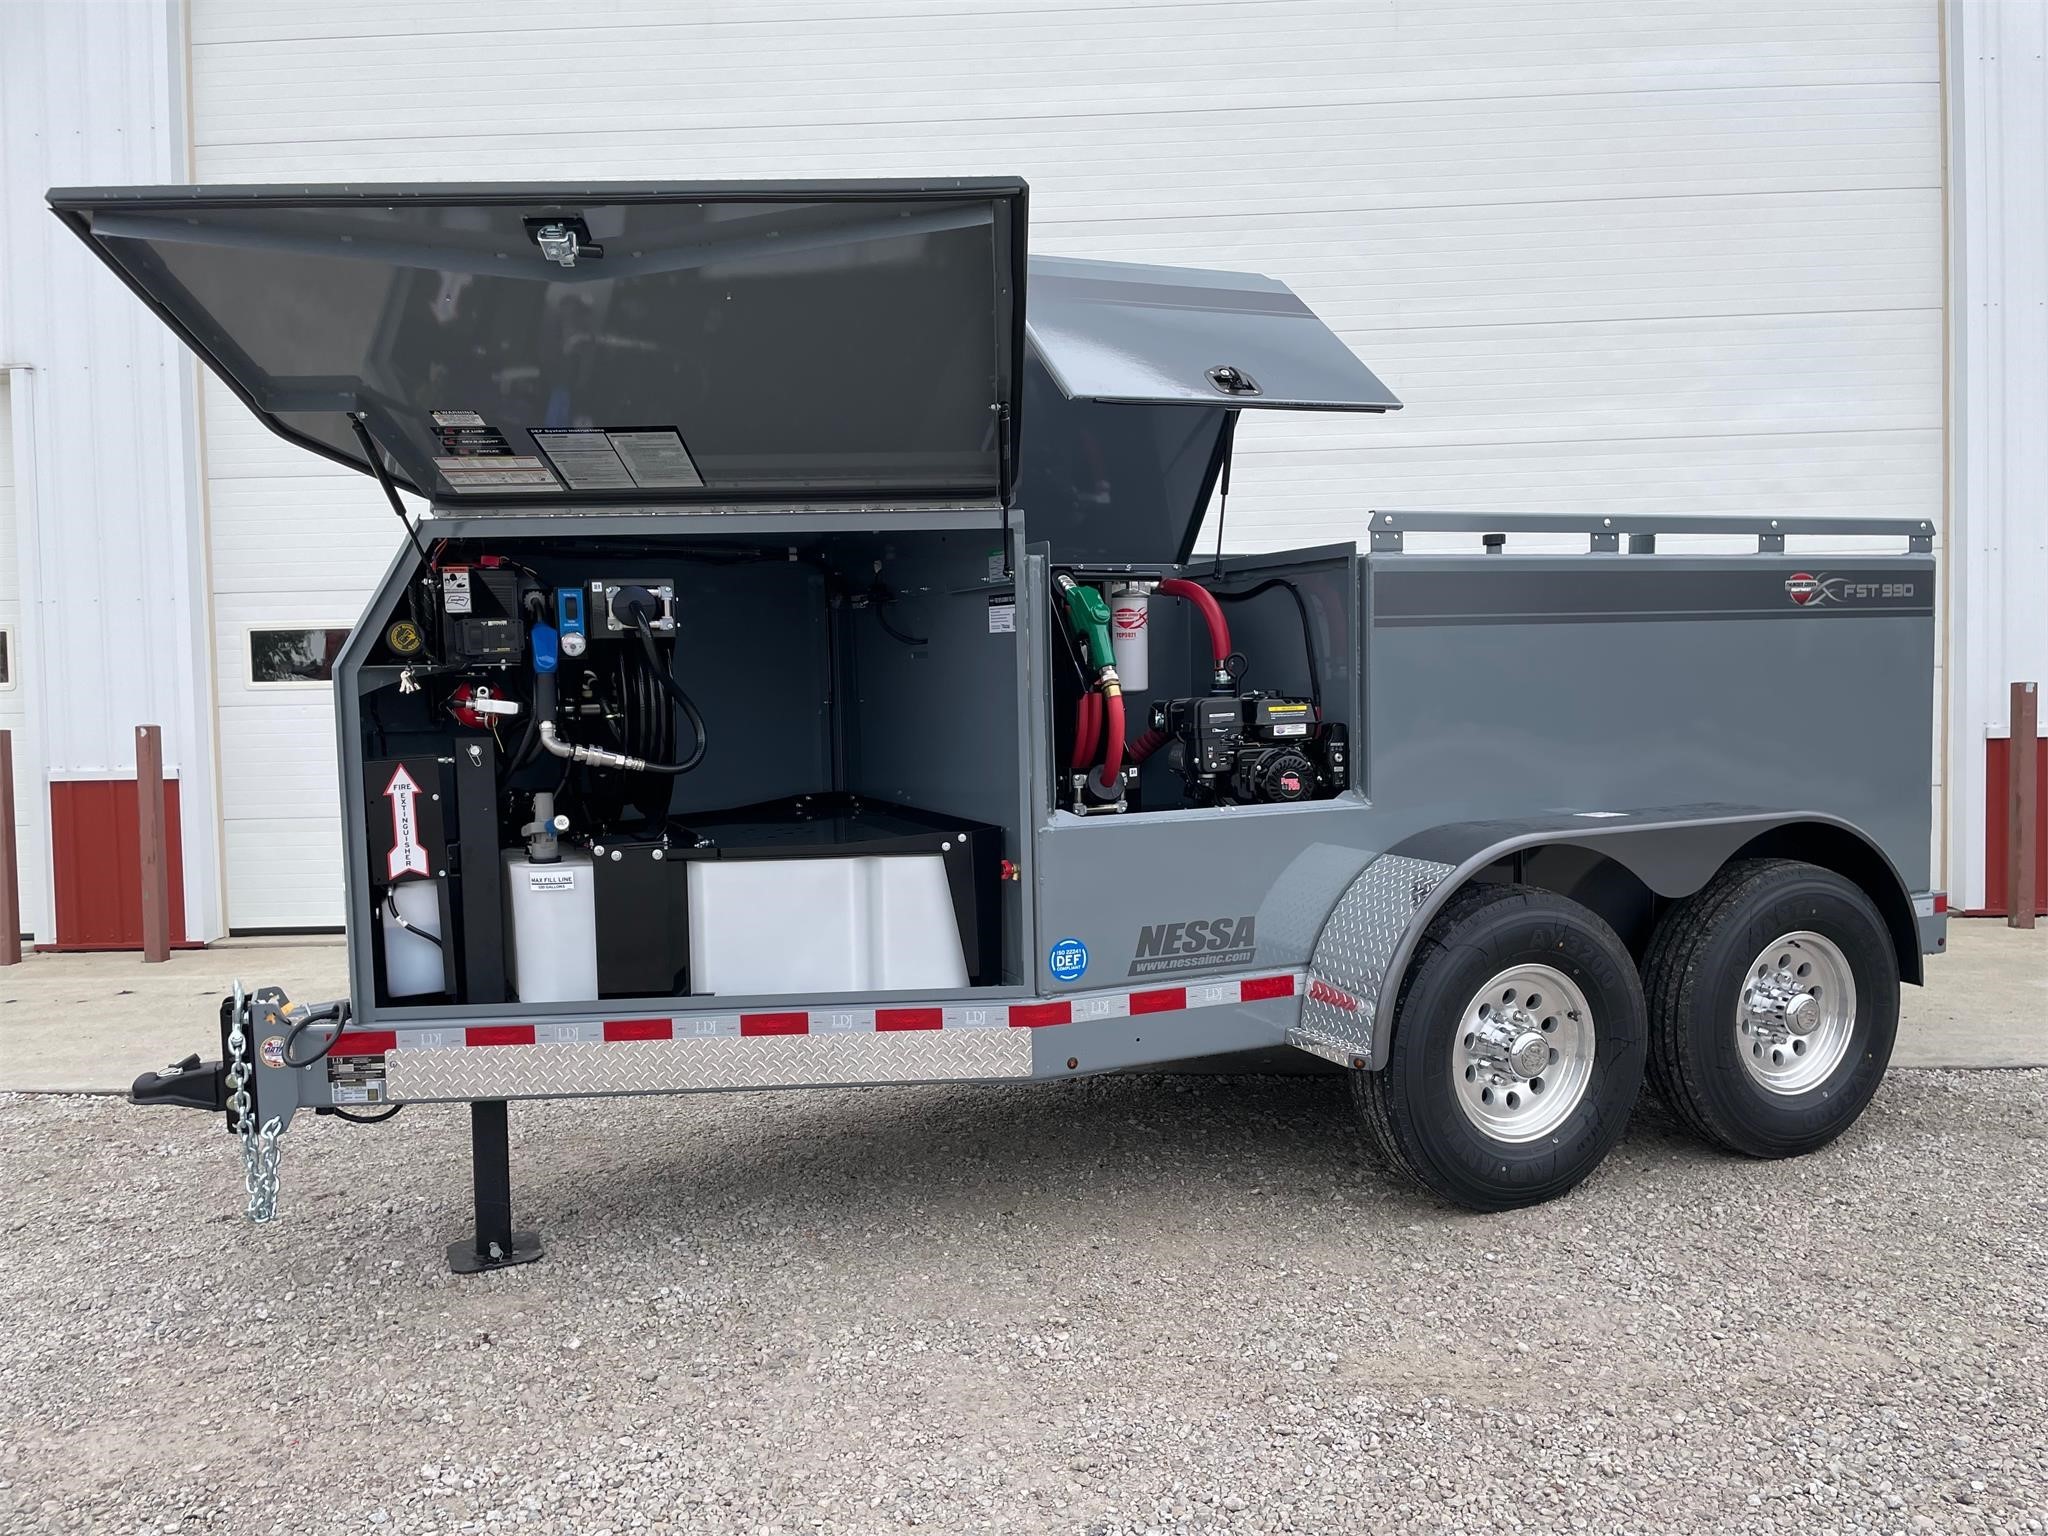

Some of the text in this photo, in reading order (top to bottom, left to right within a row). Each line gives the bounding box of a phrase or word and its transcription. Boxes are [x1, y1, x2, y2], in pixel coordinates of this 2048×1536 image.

[1844, 583, 1914, 598] FST 990
[393, 783, 412, 791] FIRE
[400, 792, 412, 867] EXTINGUISHER
[1135, 915, 1256, 958] NESSA
[1056, 954, 1082, 967] DEF
[1136, 951, 1251, 972] www.nessainc.com
